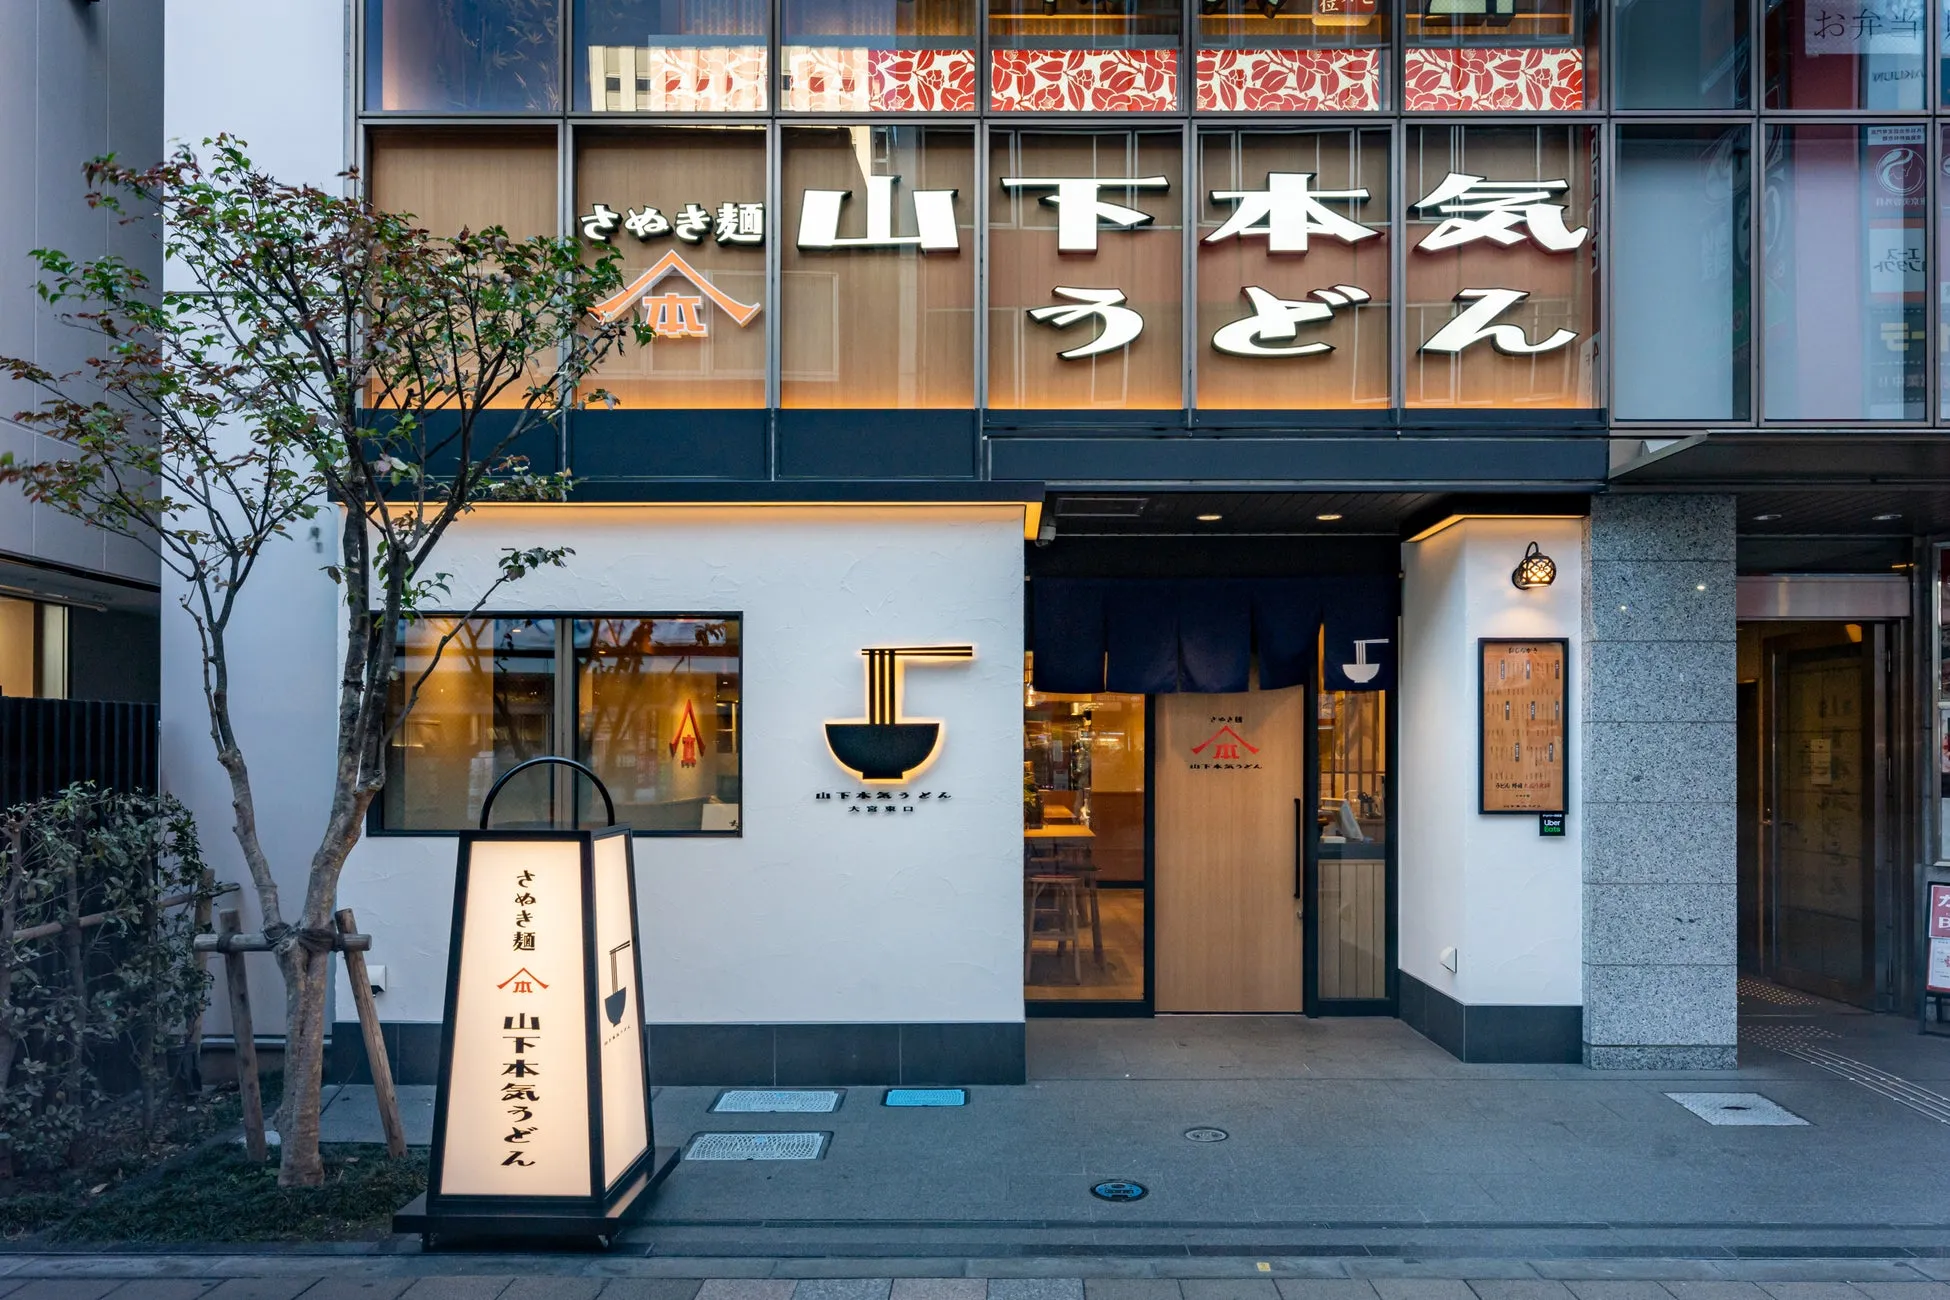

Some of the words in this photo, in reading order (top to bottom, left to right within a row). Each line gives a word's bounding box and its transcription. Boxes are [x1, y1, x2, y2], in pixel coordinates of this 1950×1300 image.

[1813, 8, 1917, 41] お弁当
[579, 202, 767, 245] さぬき麺
[1028, 284, 1578, 361] うどん
[815, 791, 952, 800] 山下本気うどん
[847, 805, 915, 814] 大宮東口
[1543, 825, 1561, 833] Eats
[512, 869, 537, 952] さぬき麺
[500, 1012, 542, 1167] 山下本気うどん
